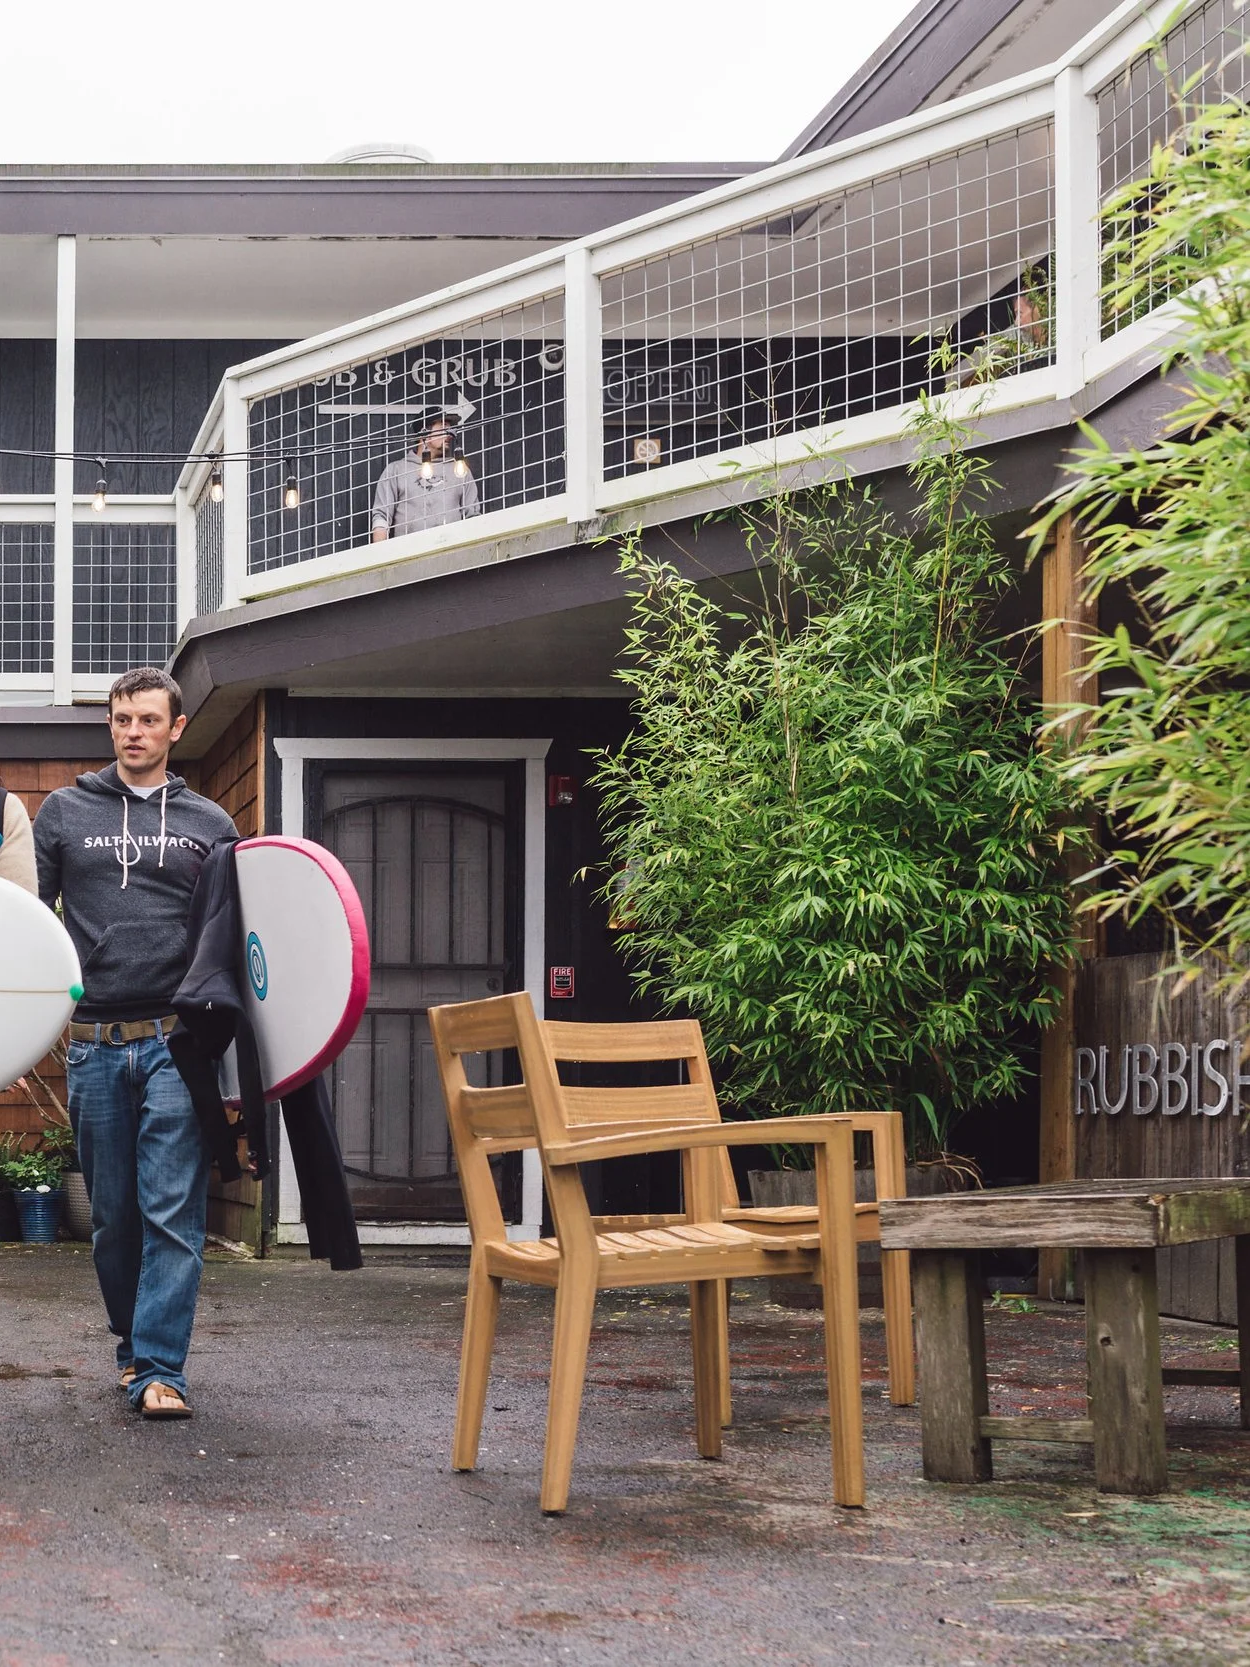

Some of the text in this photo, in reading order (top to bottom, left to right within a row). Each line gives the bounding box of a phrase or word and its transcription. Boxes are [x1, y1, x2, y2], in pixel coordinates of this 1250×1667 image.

[373, 360, 396, 386] &
[411, 357, 517, 388] GRUB
[607, 369, 706, 402] OPEN
[84, 835, 122, 849] SALT
